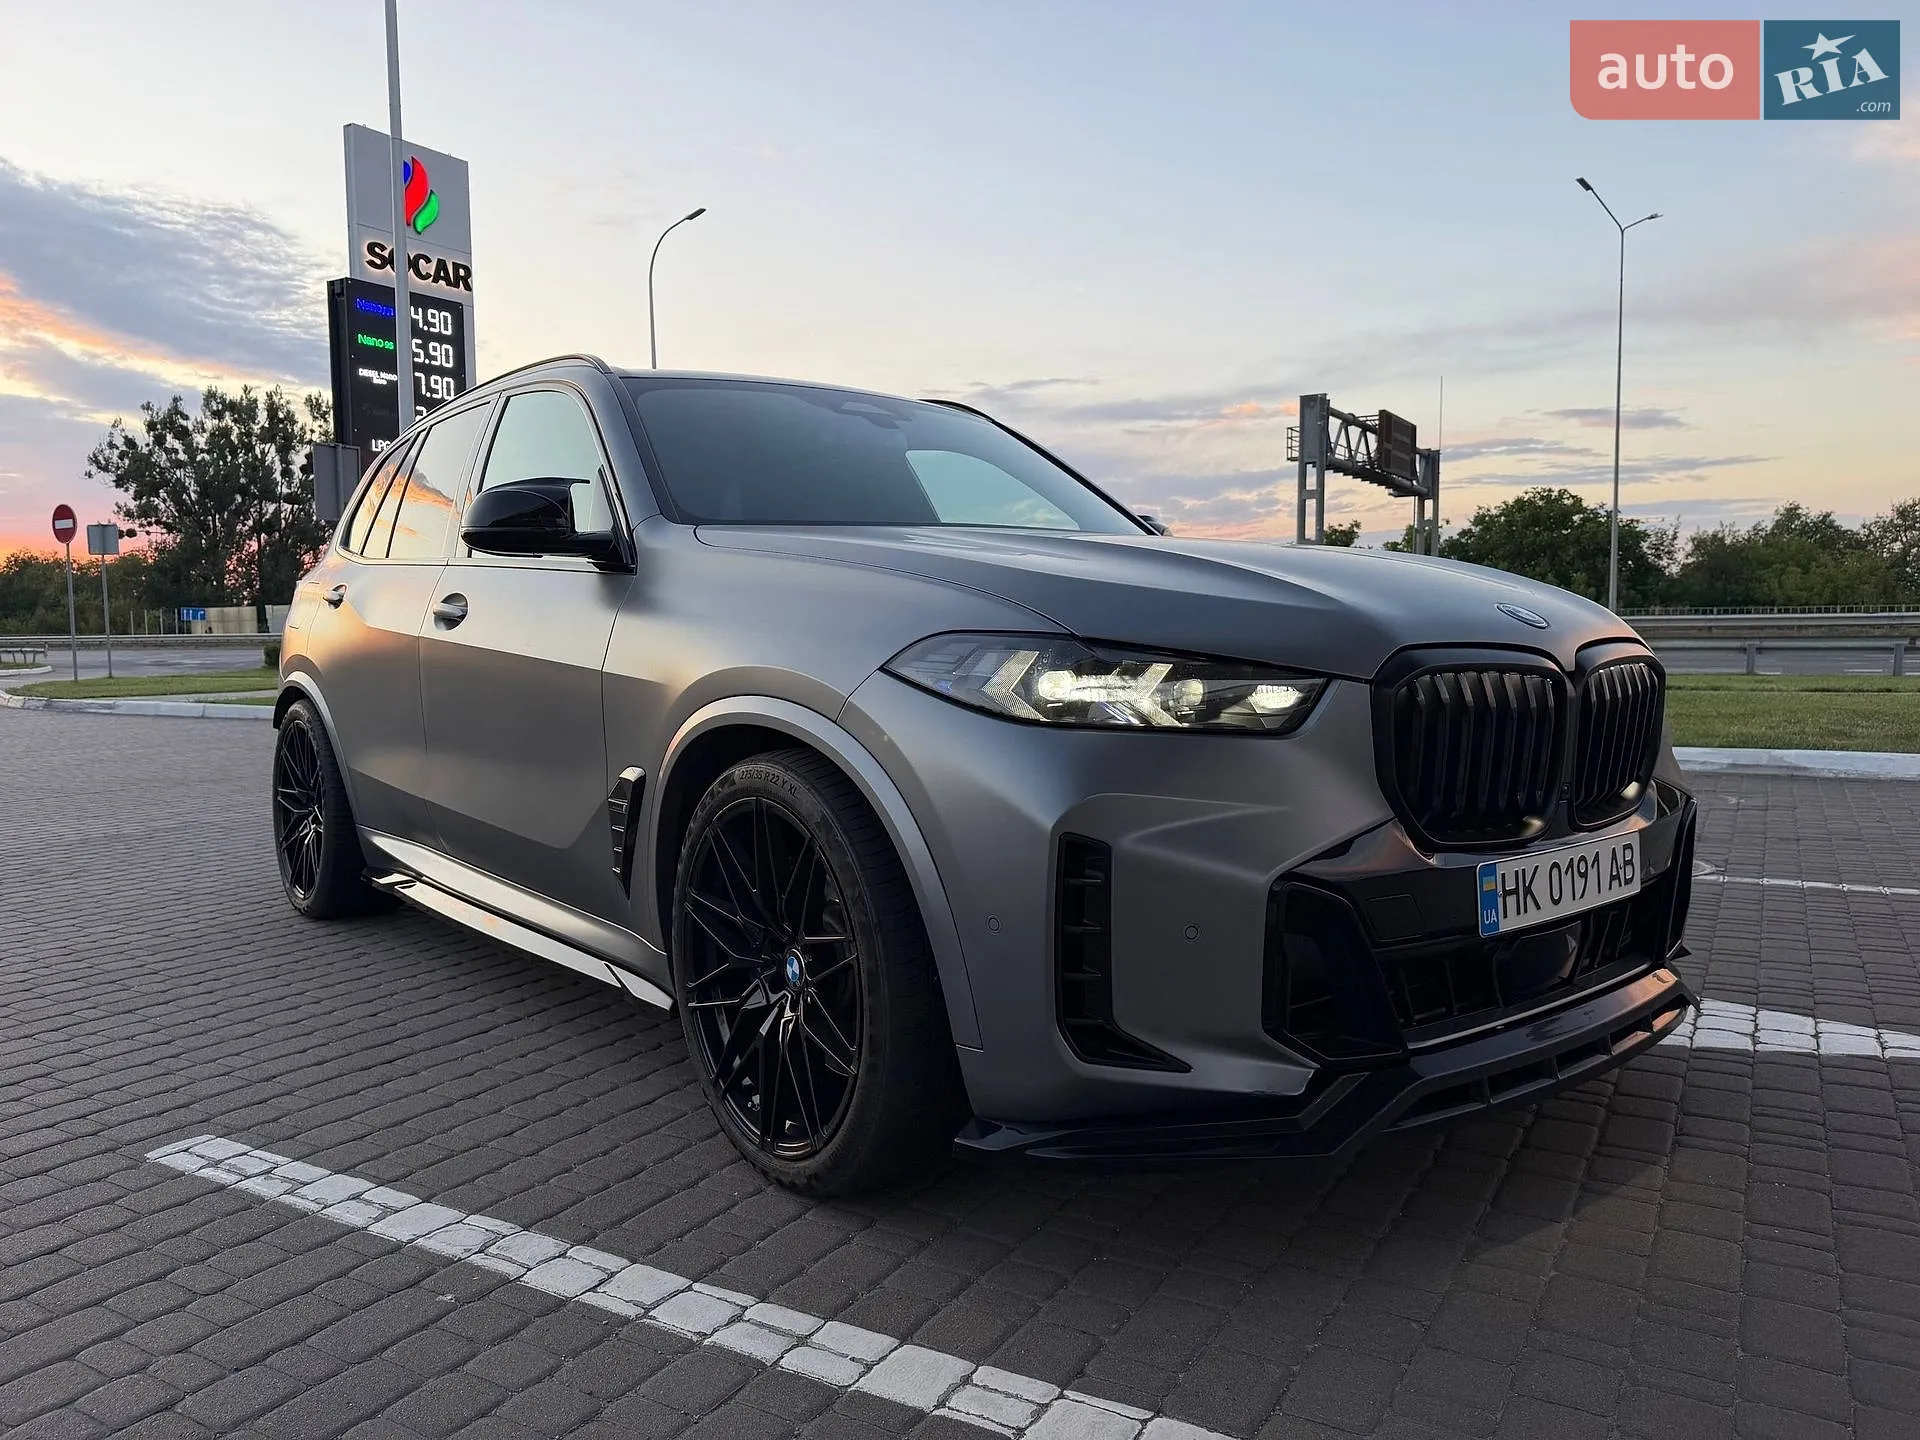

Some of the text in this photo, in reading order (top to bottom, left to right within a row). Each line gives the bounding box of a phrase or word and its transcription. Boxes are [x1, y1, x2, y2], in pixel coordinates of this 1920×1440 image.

[410, 305, 452, 335] 4.90
[358, 333, 383, 348] Nano
[411, 338, 453, 368] 5.90
[414, 371, 454, 400] 7.90
[1500, 842, 1635, 919] HK 0191 AB
[1483, 908, 1497, 925] UA
